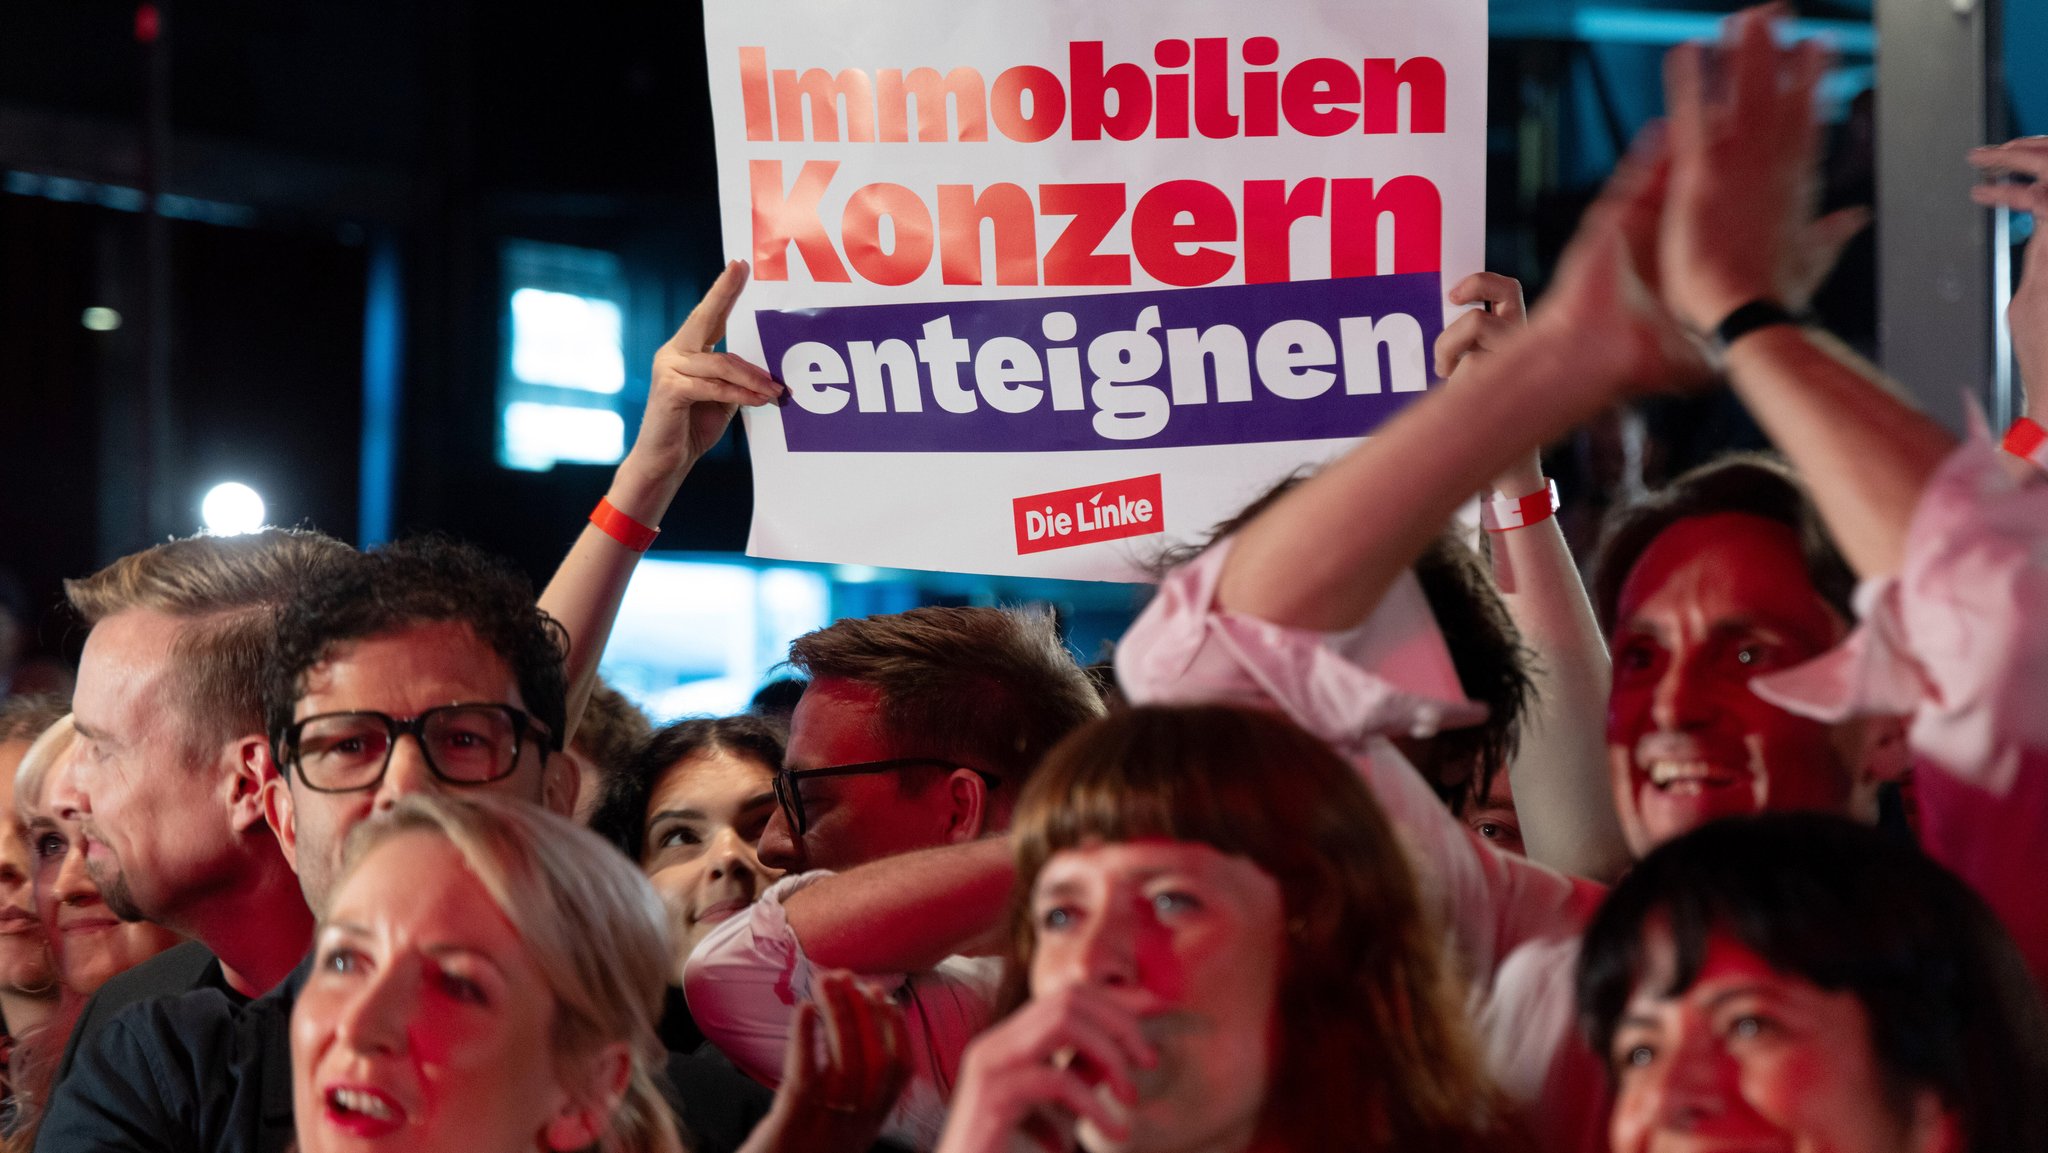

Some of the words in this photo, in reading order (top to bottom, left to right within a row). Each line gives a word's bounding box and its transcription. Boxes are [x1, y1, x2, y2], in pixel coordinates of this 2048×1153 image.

[739, 37, 1446, 142] Immobilien
[749, 159, 1442, 287] Konzern
[781, 305, 1427, 440] enteignen
[1025, 506, 1072, 541] Die
[1076, 491, 1153, 532] Linke
